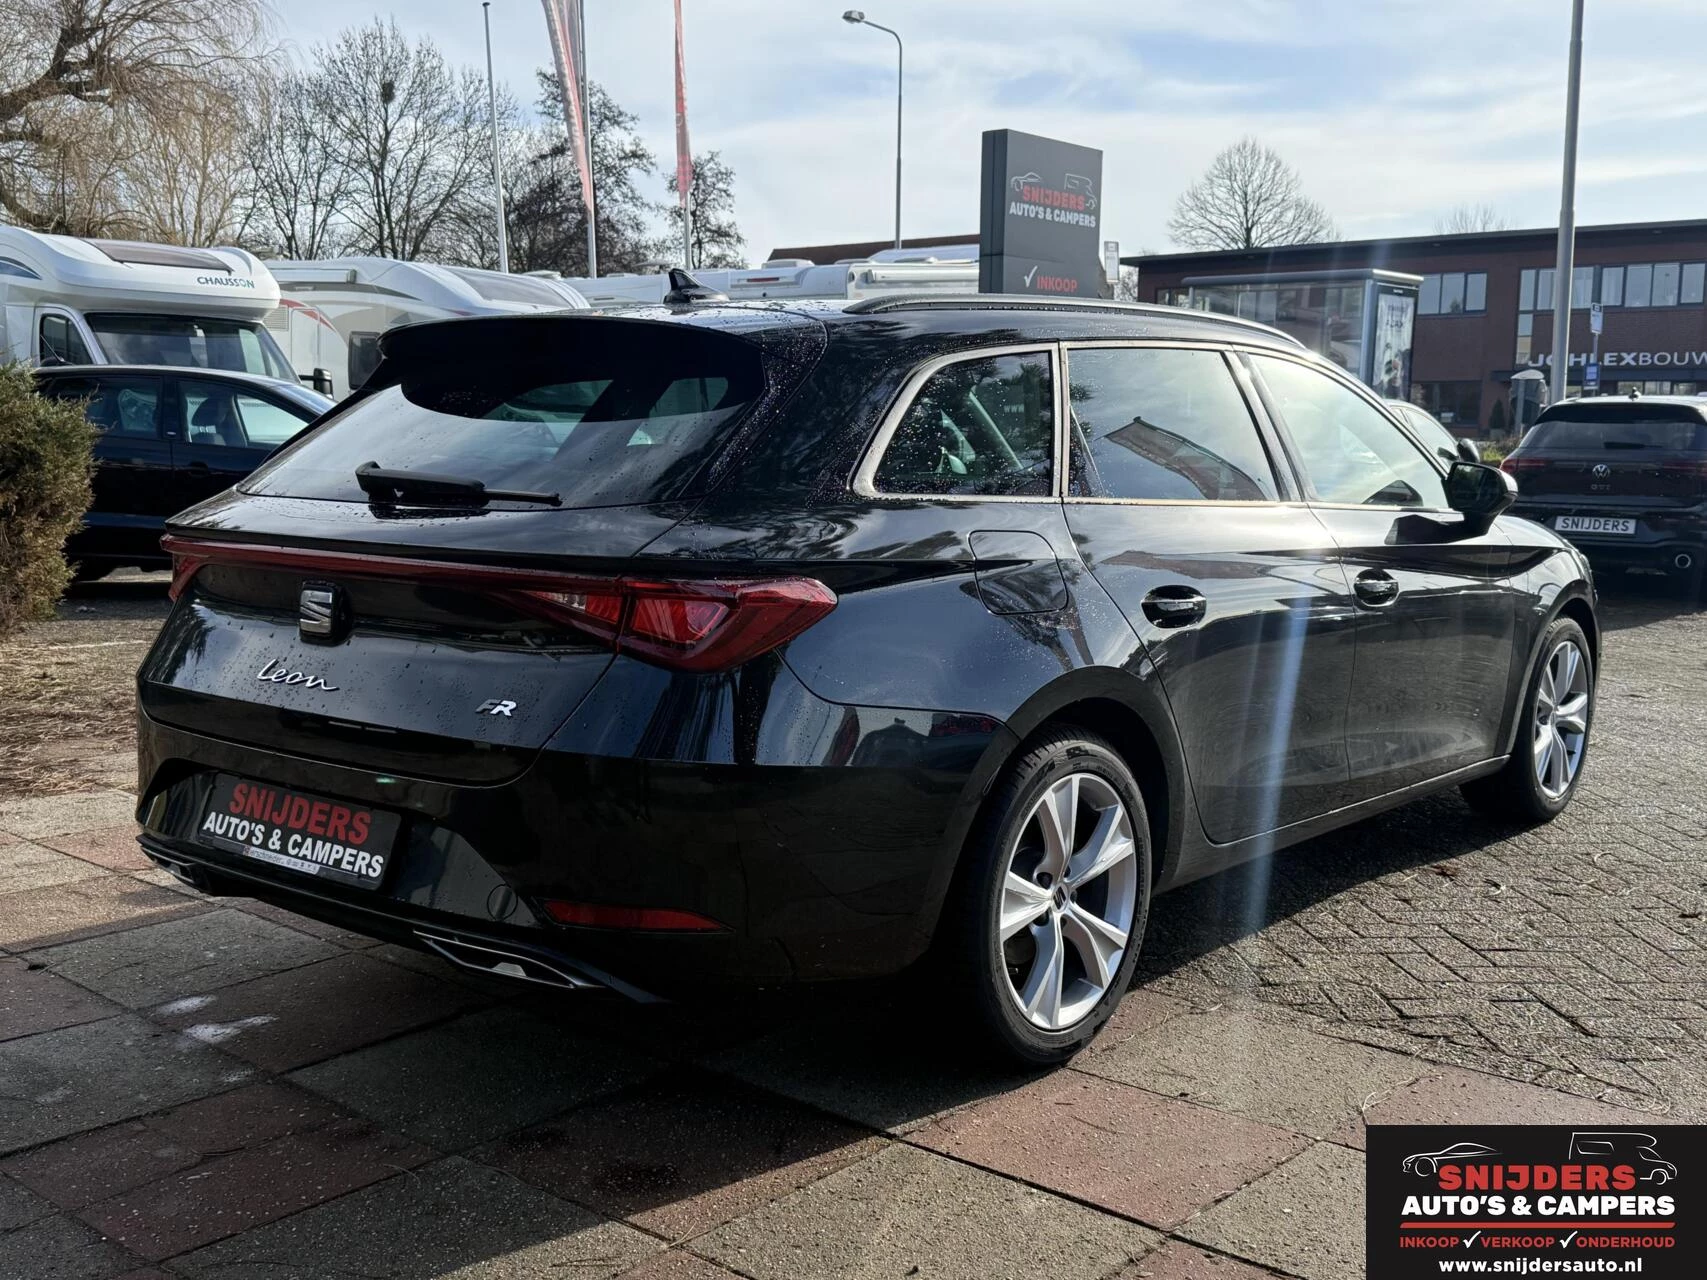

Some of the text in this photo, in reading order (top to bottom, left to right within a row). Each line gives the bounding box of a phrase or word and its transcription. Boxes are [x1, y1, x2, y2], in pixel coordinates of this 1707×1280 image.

[1022, 185, 1086, 211] SNIJDERS
[1009, 201, 1096, 228] AUTO'S & CAMPERS
[196, 276, 255, 289] CHAUSSON
[1036, 275, 1078, 293] INKOOP
[1561, 517, 1630, 532] SNIJDERS
[256, 658, 340, 692] Leon
[475, 698, 517, 717] FR
[229, 783, 372, 845] SNIJDERS
[202, 812, 384, 878] AUTO'S & CAMPERS
